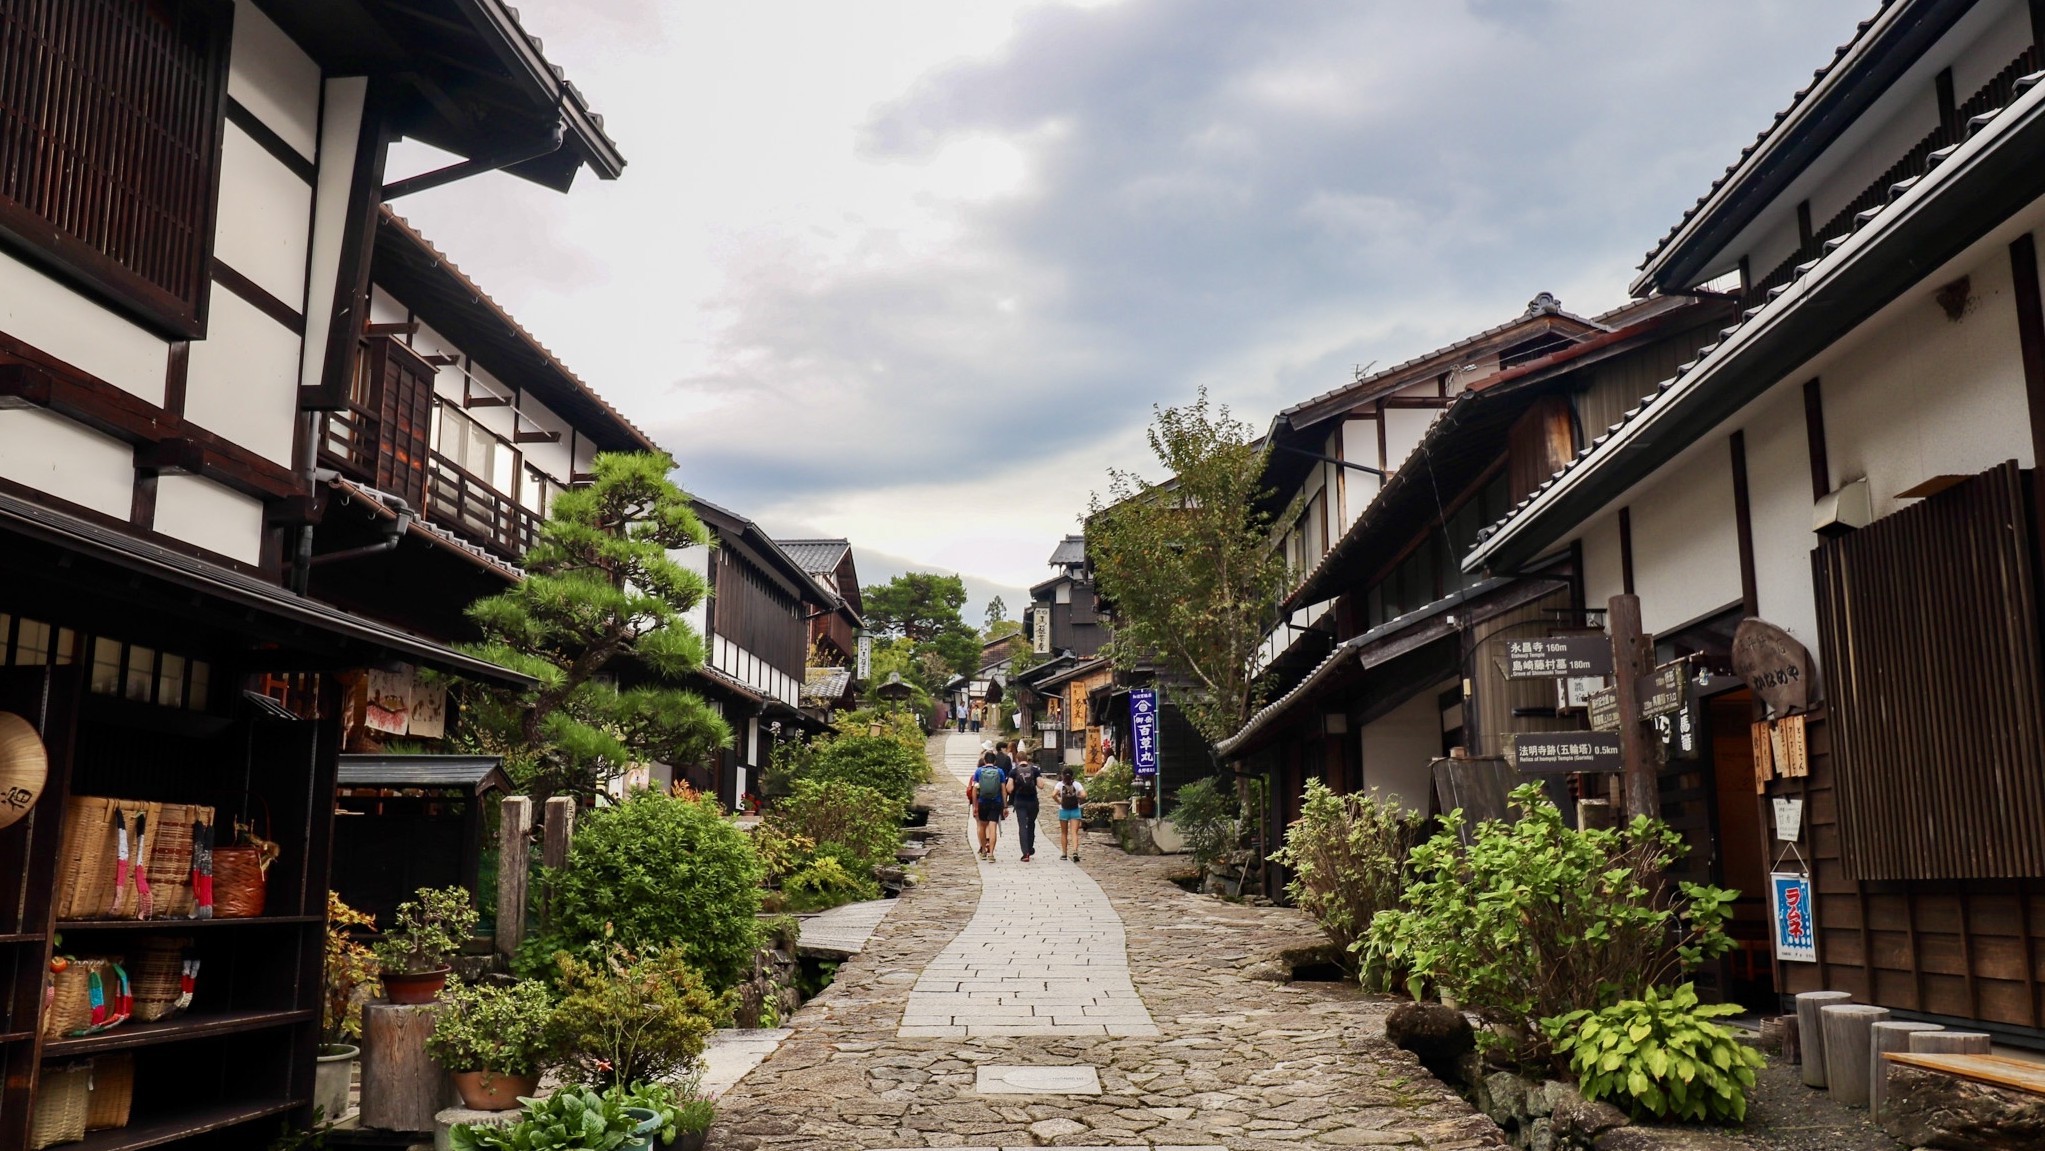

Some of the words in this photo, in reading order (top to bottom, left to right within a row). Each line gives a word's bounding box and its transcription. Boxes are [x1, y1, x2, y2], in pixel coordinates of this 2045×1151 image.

[1511, 642, 1543, 653] 永昌寺
[1546, 644, 1567, 652] 160m
[1569, 661, 1591, 669] 180m
[1753, 665, 1799, 690] かなめや
[1137, 724, 1154, 762] 百草丸
[1594, 746, 1618, 754] 0.5km
[1785, 887, 1804, 938] ラムネ
